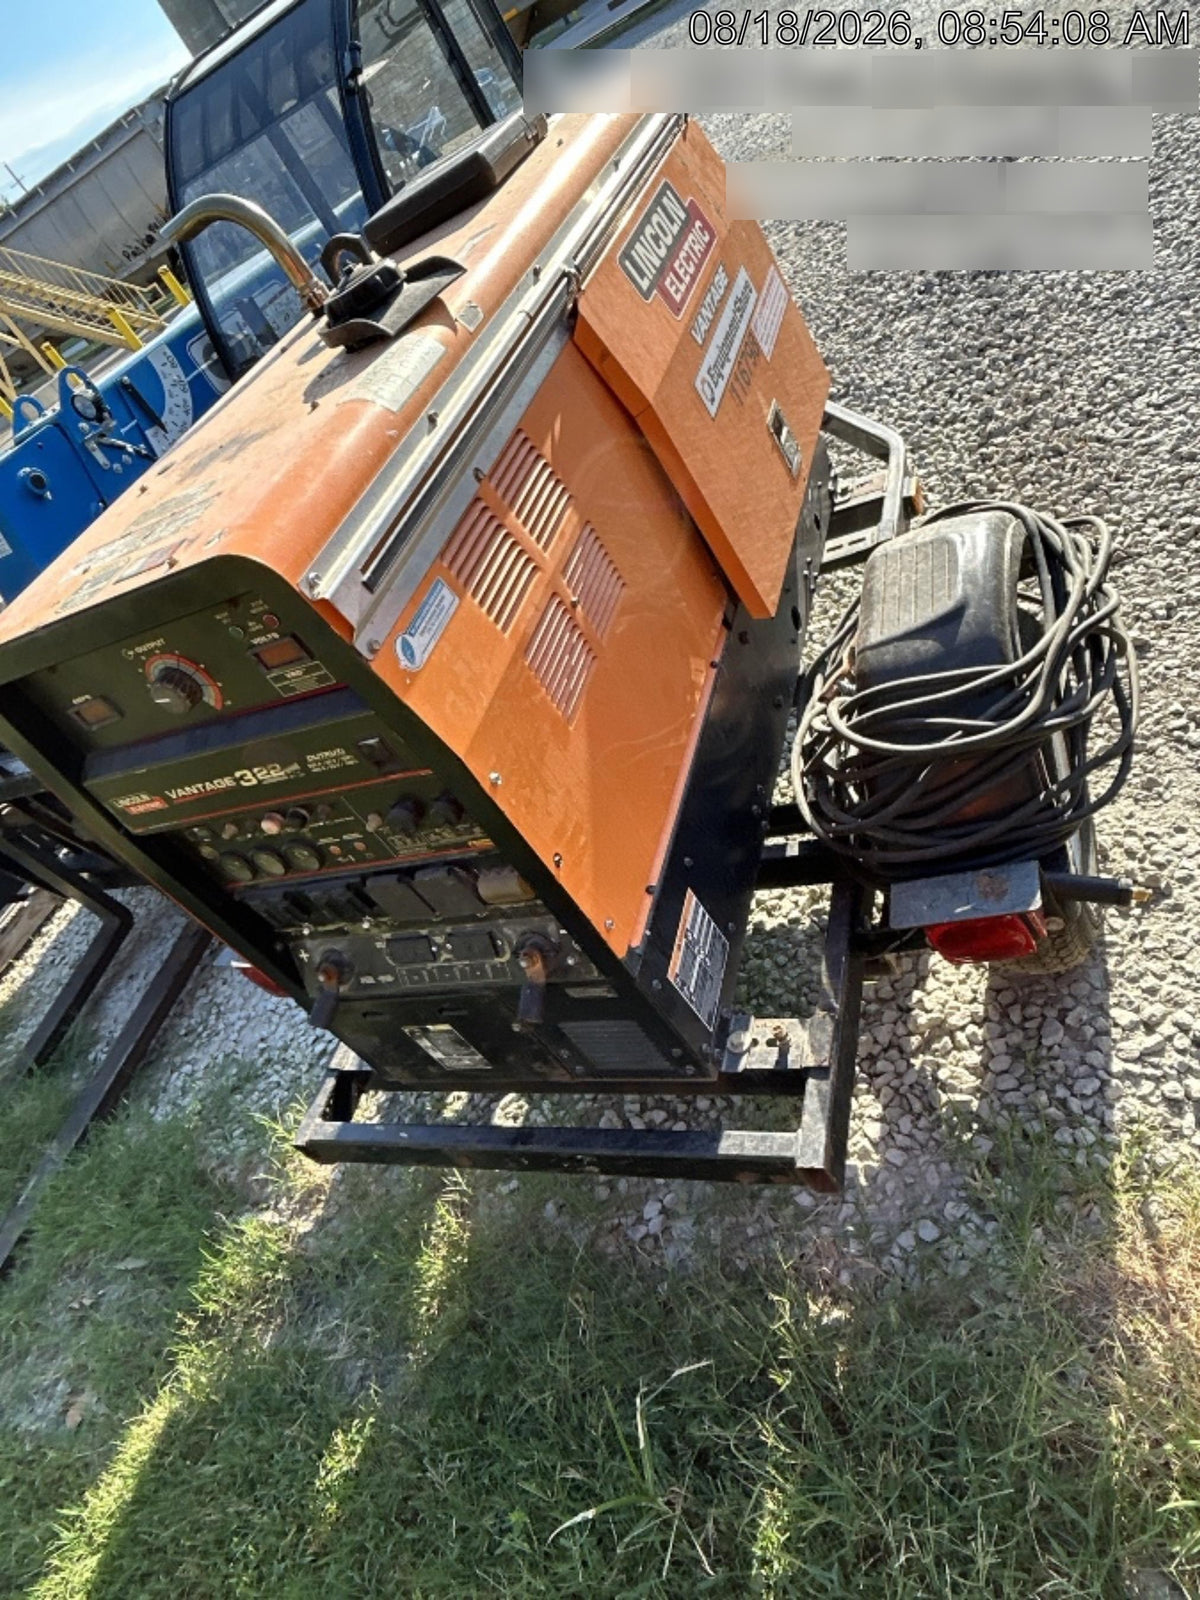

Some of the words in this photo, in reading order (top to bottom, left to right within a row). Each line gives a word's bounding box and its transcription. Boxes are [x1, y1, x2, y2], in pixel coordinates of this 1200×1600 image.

[624, 189, 687, 292] LINCOLN
[664, 219, 711, 303] ELECTRIC
[690, 262, 729, 346] VANTAGE
[706, 279, 753, 389] EquipmentShare
[164, 775, 238, 800] VANTAGE
